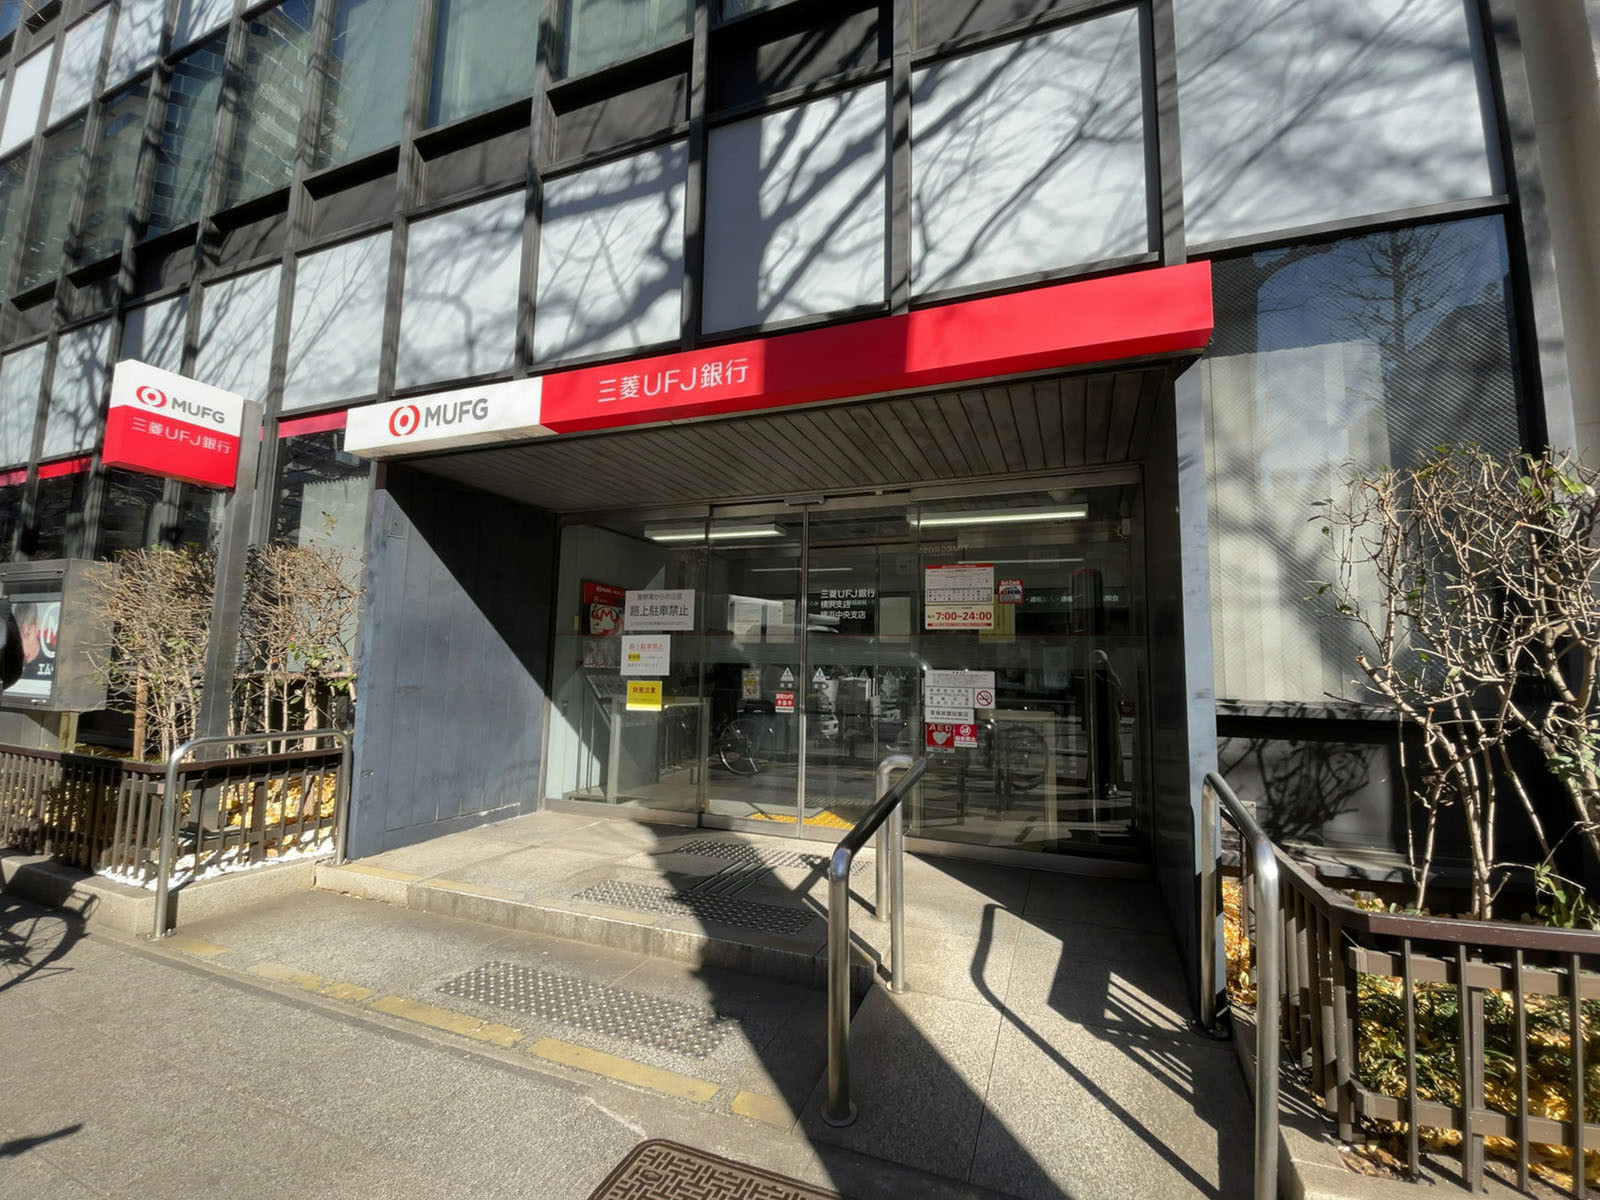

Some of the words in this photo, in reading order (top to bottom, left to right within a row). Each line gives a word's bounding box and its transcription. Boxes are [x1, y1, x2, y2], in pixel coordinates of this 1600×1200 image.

[598, 358, 749, 403] 三菱UFJ銀行
[172, 397, 225, 424] MUFG
[424, 398, 489, 428] MUFG
[131, 417, 232, 454] 三菱UFJ銀行
[820, 588, 876, 599] 三菱UFJ銀行
[630, 604, 689, 616] 路上駐車禁止
[928, 724, 953, 732] AED
